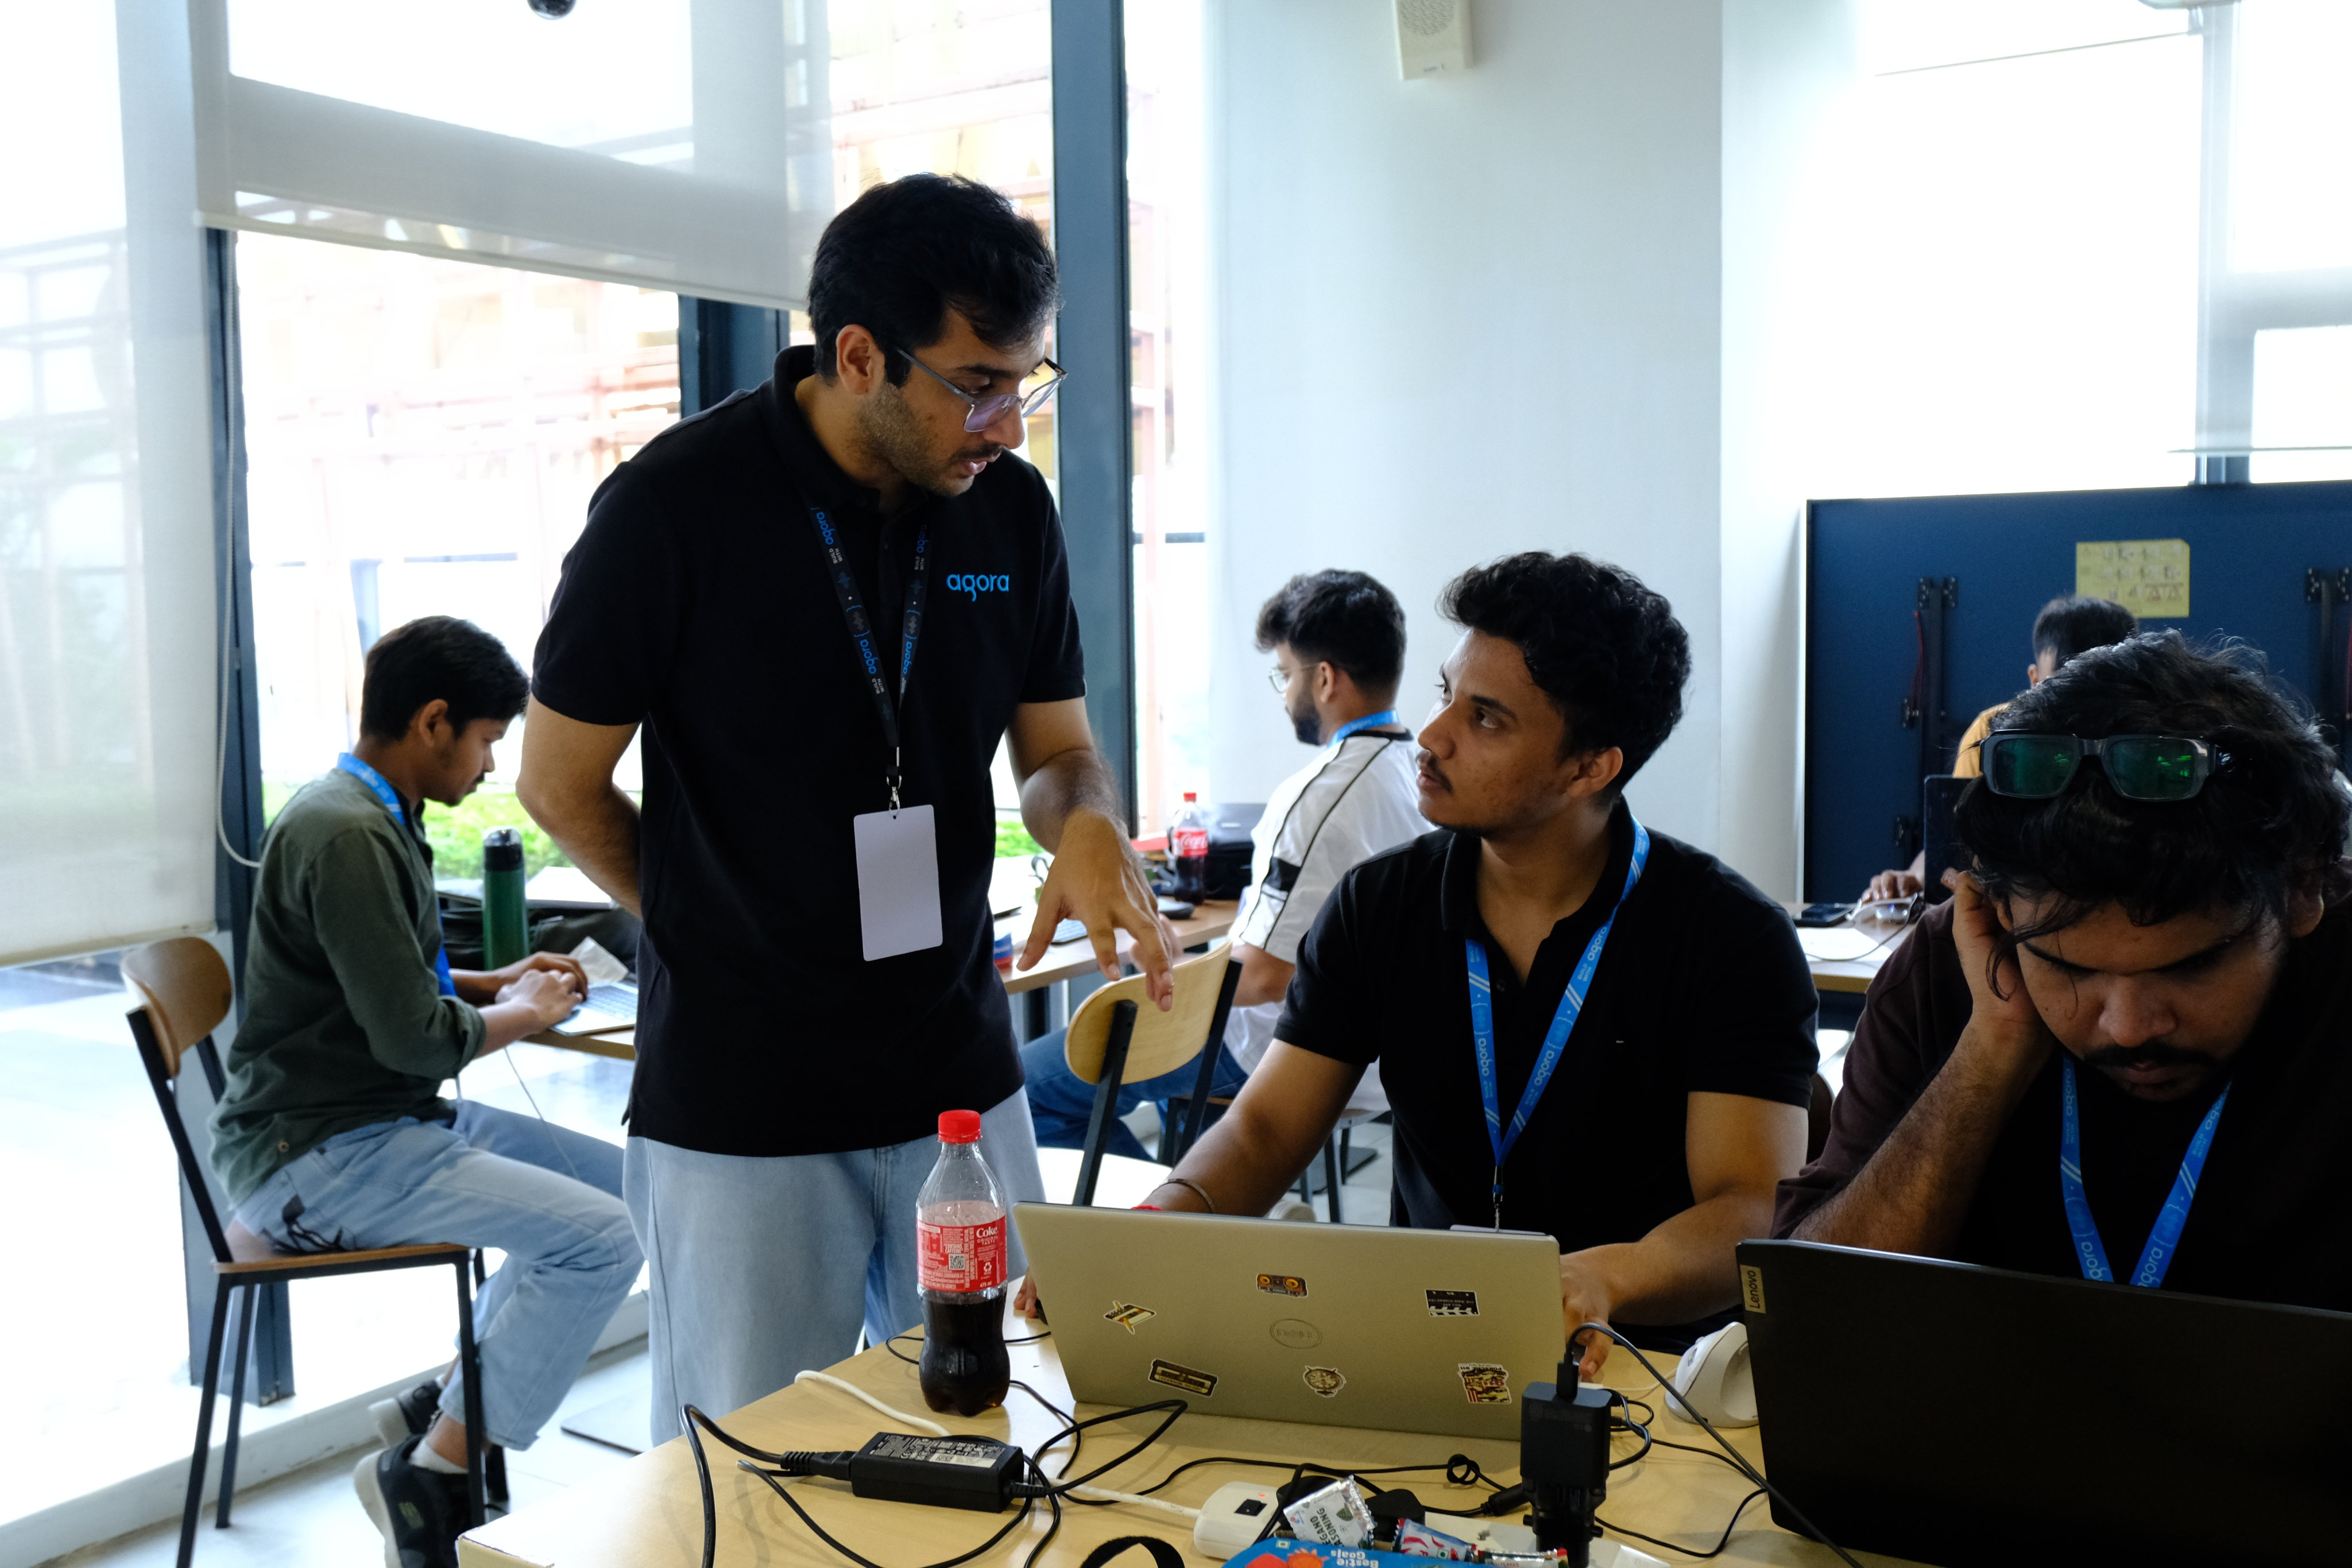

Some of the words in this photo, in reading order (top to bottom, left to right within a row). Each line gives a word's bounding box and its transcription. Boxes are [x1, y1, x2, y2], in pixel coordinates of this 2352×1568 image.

[817, 512, 835, 545] agora
[916, 524, 930, 553] agora
[829, 548, 838, 564] BUILD
[834, 547, 843, 562] WITH
[946, 574, 1009, 602] agora
[860, 638, 877, 675] agora
[902, 641, 913, 675] agora
[872, 678, 880, 695] BUILD
[877, 678, 885, 693] WITH
[1478, 1037, 1493, 1077] agora
[1534, 1050, 1555, 1086] agora
[976, 1226, 998, 1238] Coke
[2081, 1241, 2108, 1281] gora
[1747, 1270, 1761, 1309] Lenovo
[1317, 1508, 1342, 1546] ASONING
[1330, 1548, 1365, 1559] Goals
[1337, 1557, 1379, 1568] Bestie
